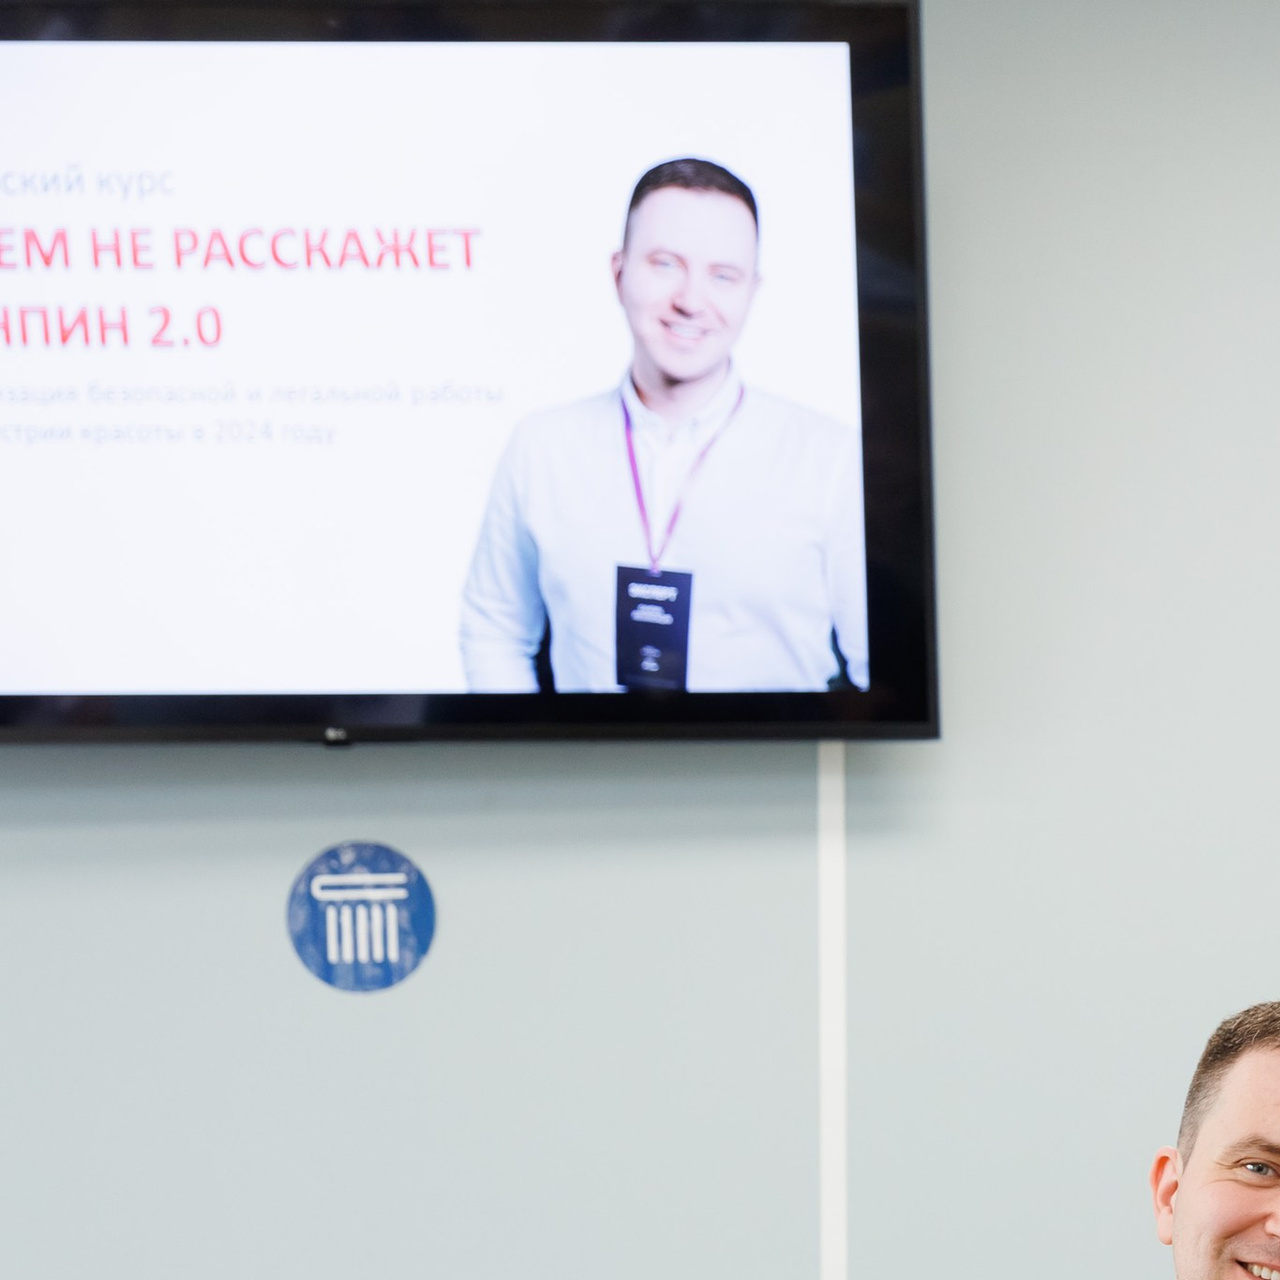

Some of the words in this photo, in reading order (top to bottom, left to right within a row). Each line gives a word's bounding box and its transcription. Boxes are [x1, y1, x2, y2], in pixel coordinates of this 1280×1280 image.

[96, 170, 176, 204] курс
[0, 229, 71, 270] ЕМ
[90, 229, 155, 270] НЕ
[173, 229, 481, 271] РАССКАЖЕТ
[149, 305, 224, 347] 2.0
[411, 379, 505, 406] работы
[80, 423, 182, 446] красоты
[214, 419, 273, 442] 2024
[281, 422, 337, 446] году
